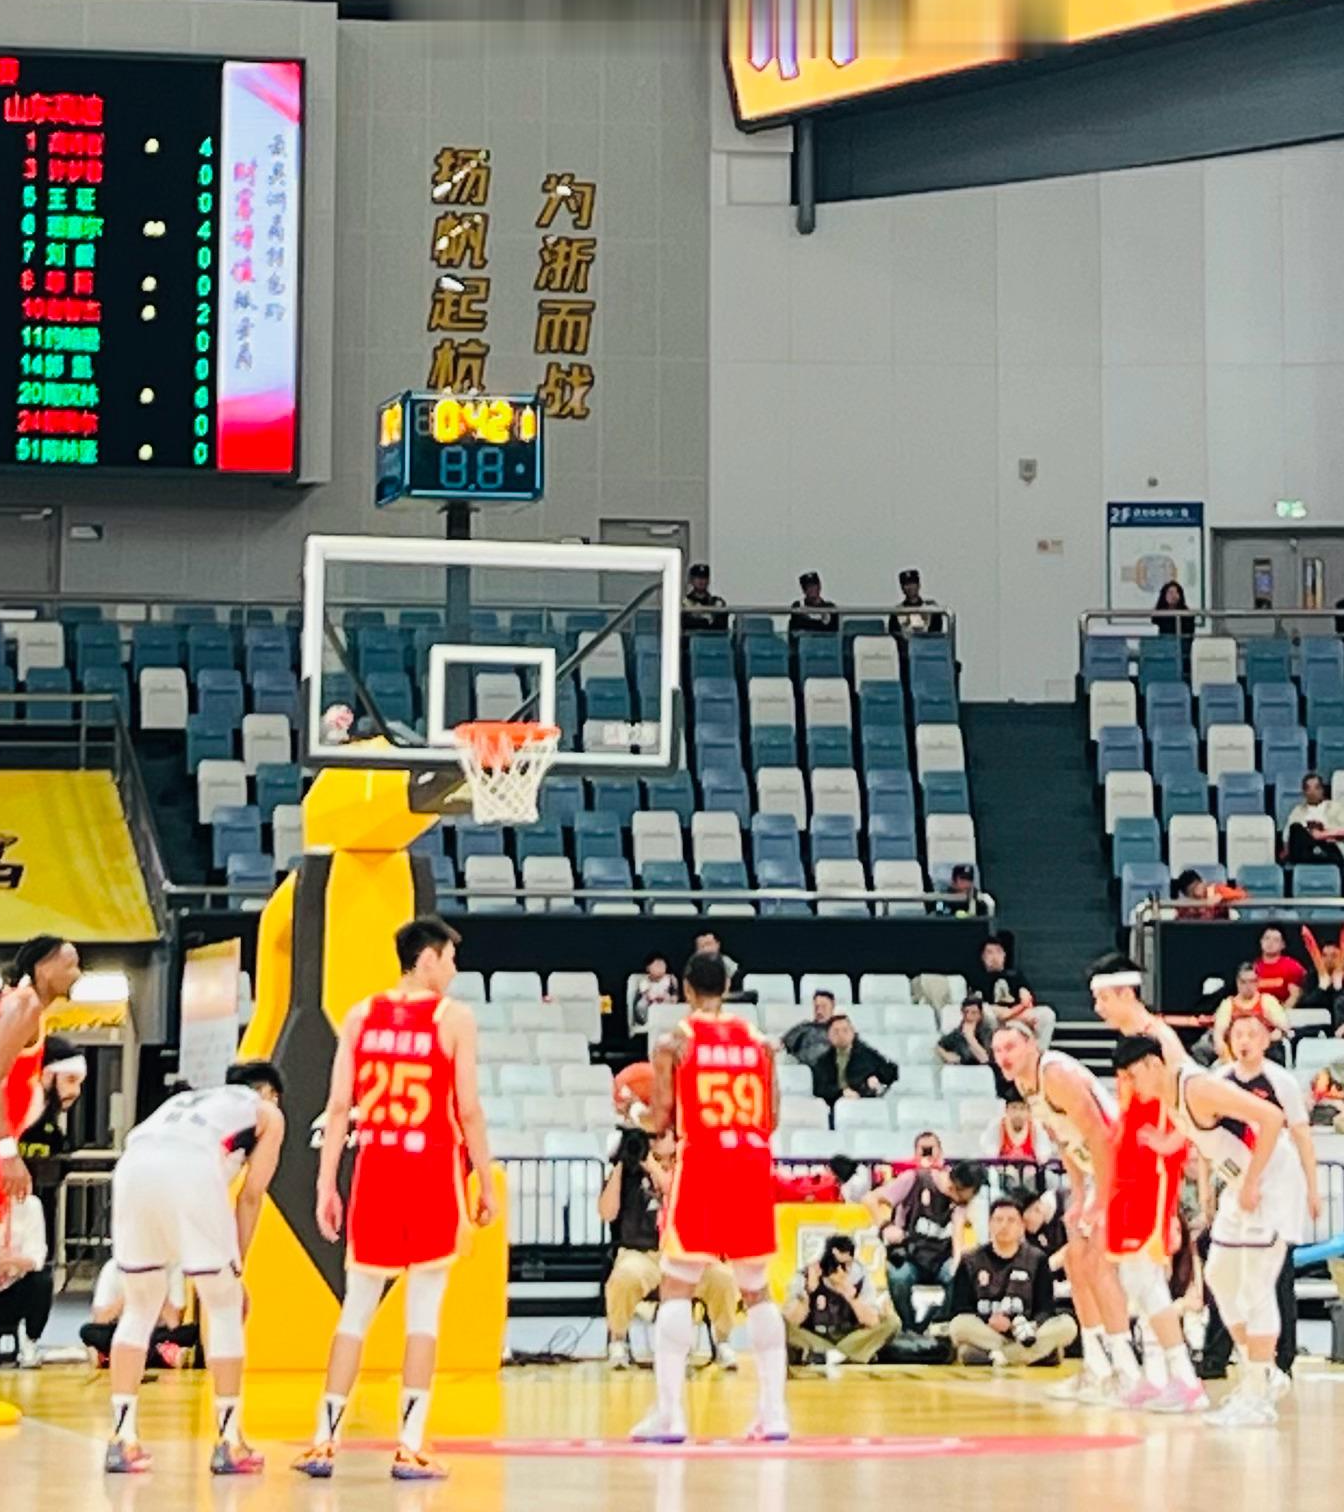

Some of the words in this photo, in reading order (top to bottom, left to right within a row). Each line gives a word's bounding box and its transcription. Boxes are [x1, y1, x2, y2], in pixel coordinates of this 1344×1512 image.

[199, 136, 213, 157] 4
[197, 220, 211, 240] 4
[535, 173, 596, 419] 为浙而战
[196, 303, 211, 325] 2
[21, 326, 43, 346] 11
[17, 381, 42, 404] 20
[358, 1060, 433, 1127] 25
[697, 1072, 764, 1127] 59
